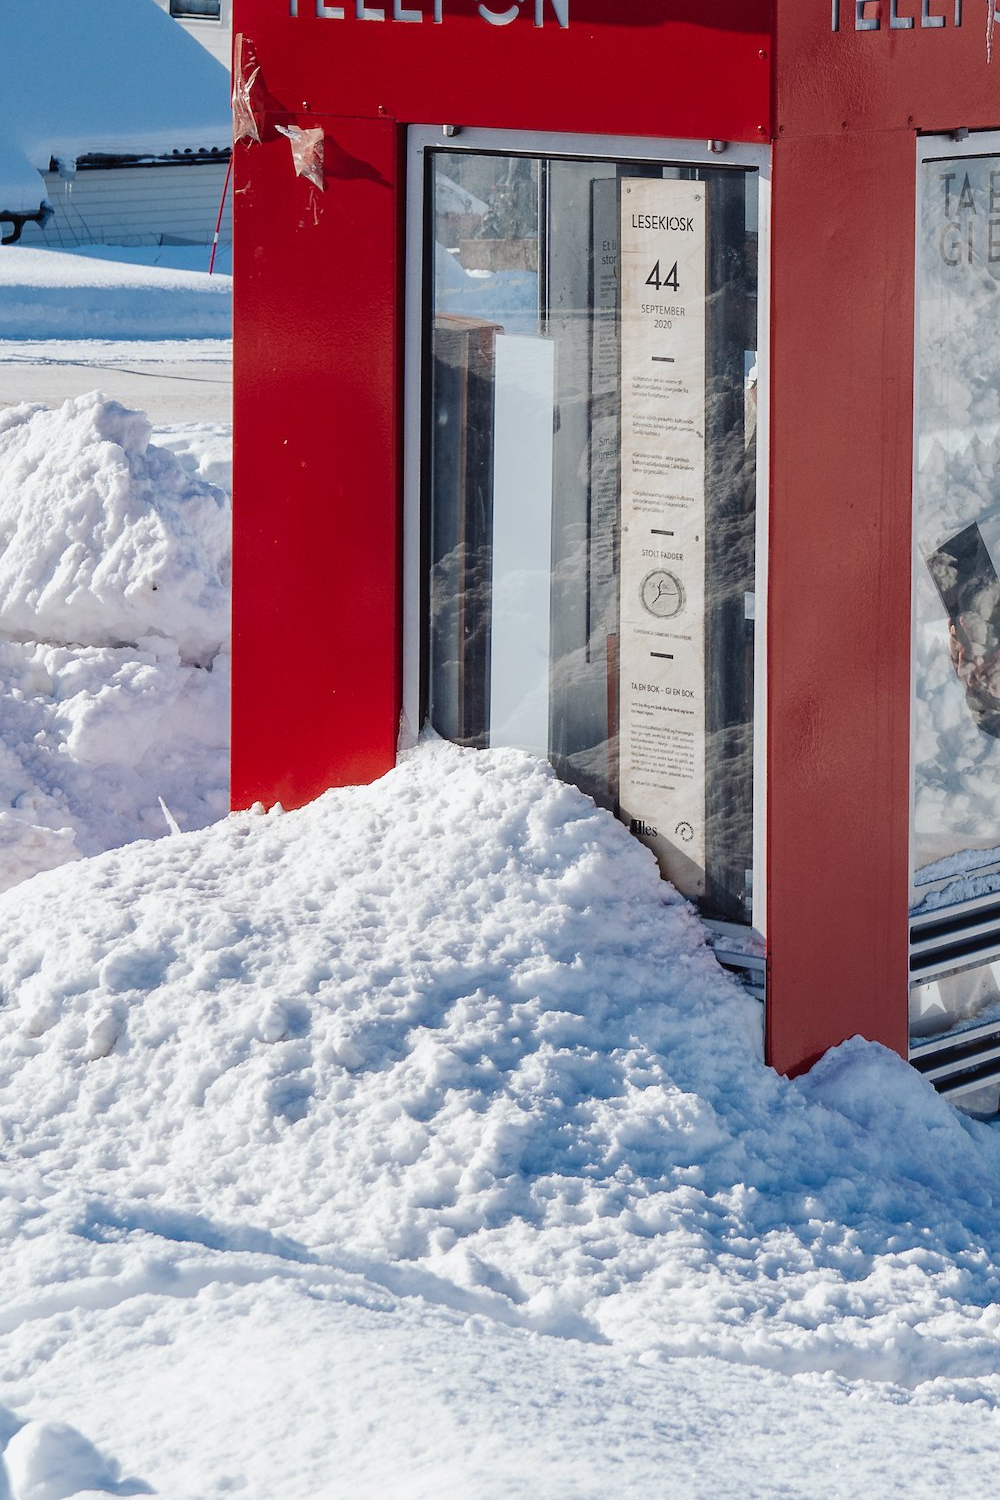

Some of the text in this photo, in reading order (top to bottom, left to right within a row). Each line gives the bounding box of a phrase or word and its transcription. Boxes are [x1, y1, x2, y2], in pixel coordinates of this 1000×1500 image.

[939, 172, 978, 217] TA
[632, 214, 694, 232] LESEKIOSK
[939, 221, 974, 267] GI
[645, 259, 680, 292] 44
[641, 304, 686, 316] SEPTEMBER
[654, 319, 672, 330] 2020
[642, 549, 684, 561] STOLT FADDER
